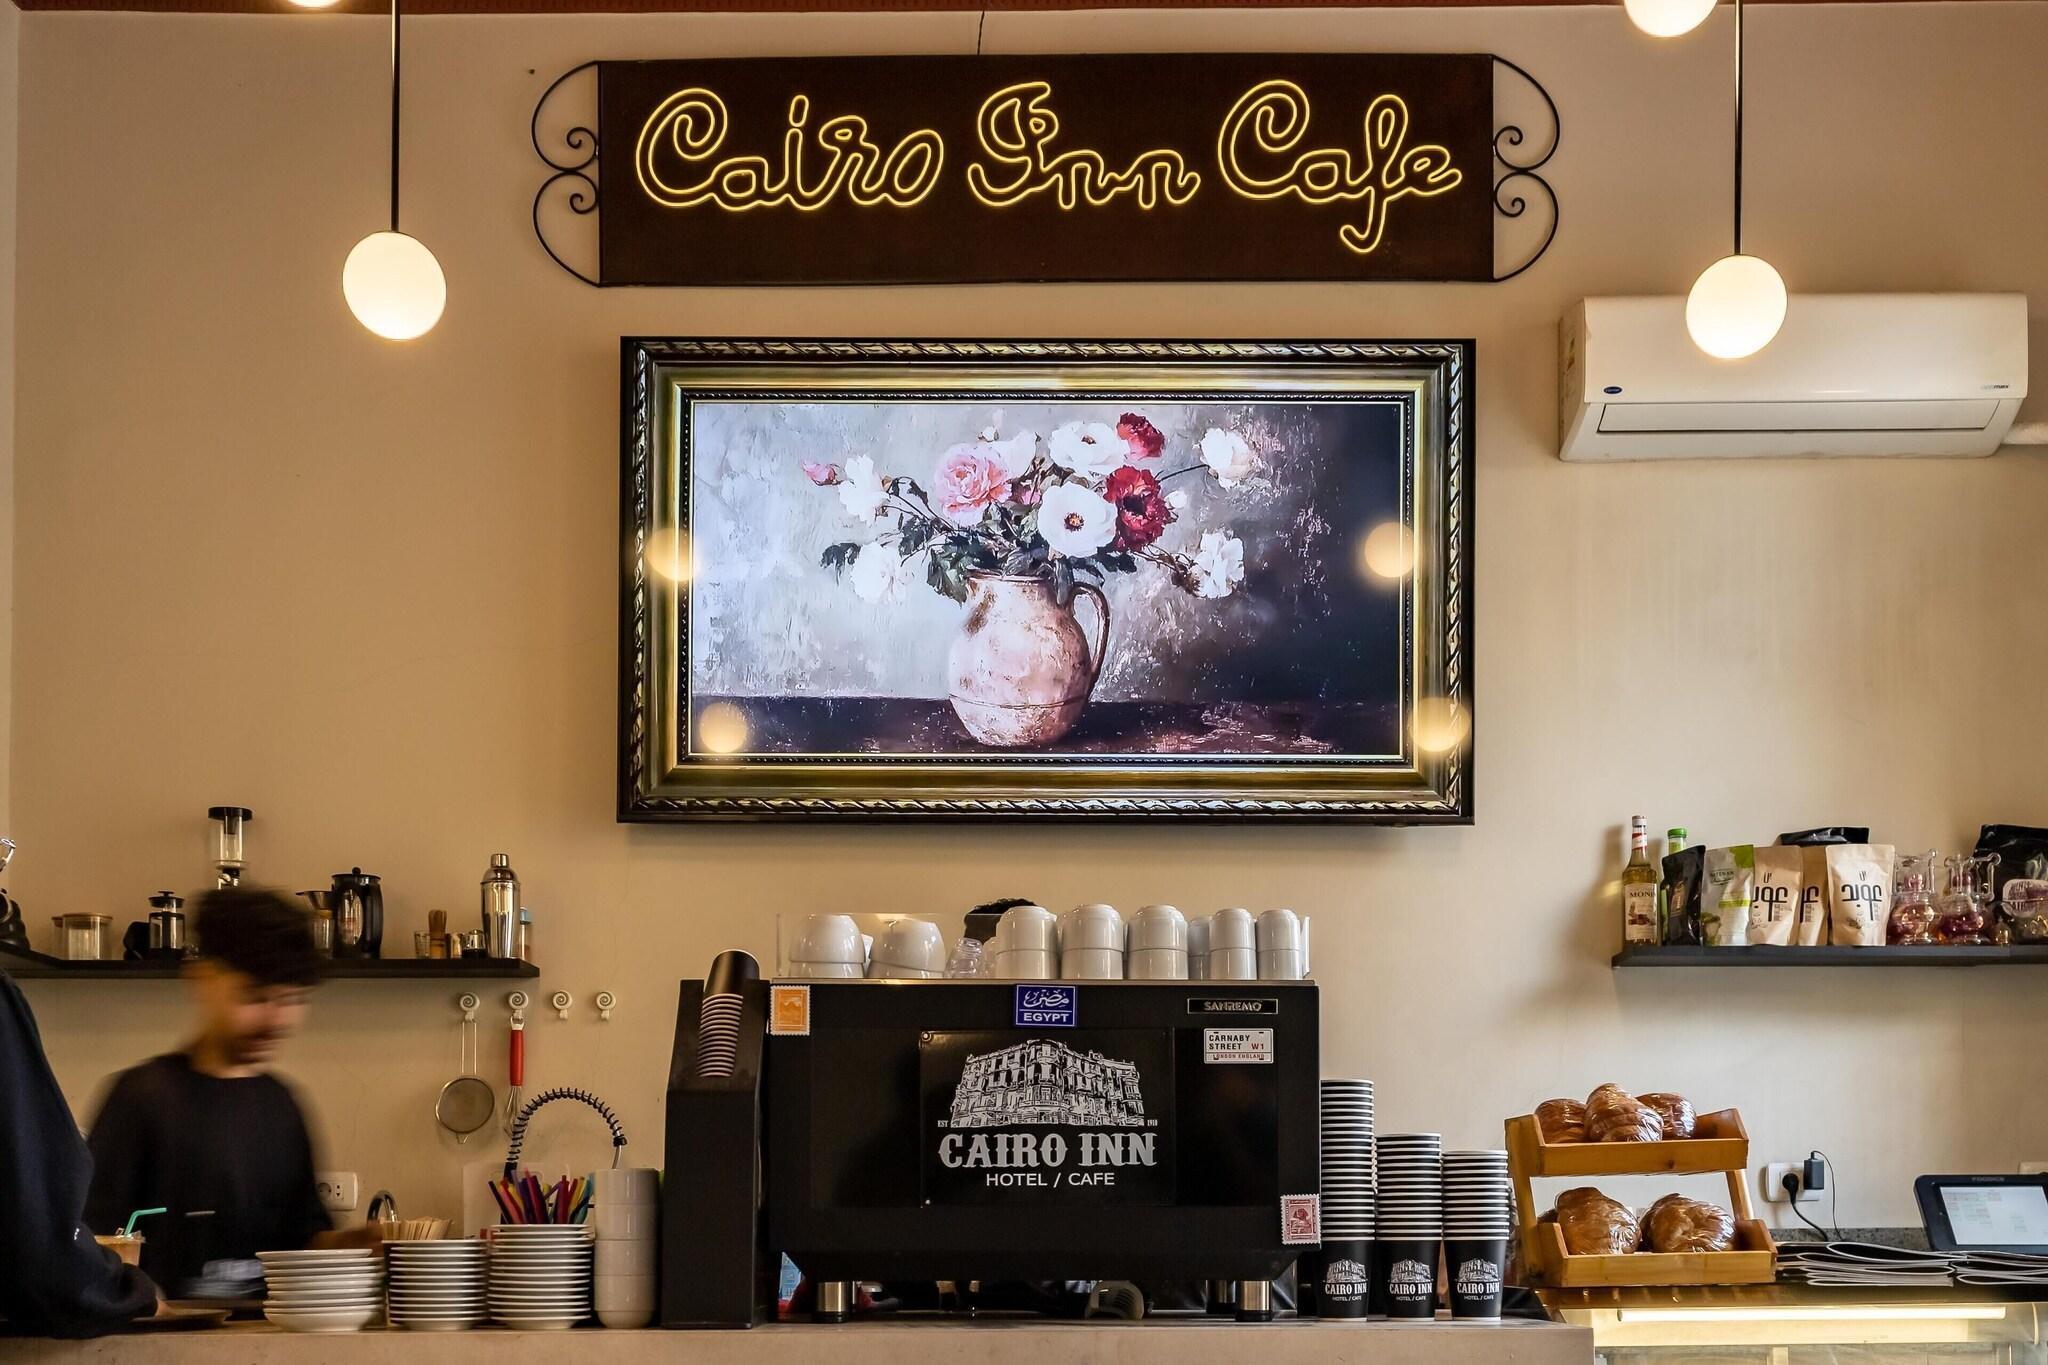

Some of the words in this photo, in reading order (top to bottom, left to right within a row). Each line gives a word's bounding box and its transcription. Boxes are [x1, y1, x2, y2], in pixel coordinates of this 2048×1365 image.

[636, 88, 944, 210] Cairo
[968, 81, 1201, 210] Inn
[1218, 80, 1463, 254] Cafe
[1204, 1001, 1262, 1012] SANREMO
[1023, 1012, 1070, 1023] EGYPT
[1209, 1034, 1250, 1042] CARNABY
[937, 1119, 949, 1128] EST
[938, 1133, 1068, 1168] CAIRO
[1077, 1132, 1158, 1167] INN
[986, 1173, 1048, 1187] HOTEL
[1068, 1172, 1115, 1186] CAFE
[1325, 1284, 1352, 1295] CAIRO
[1354, 1282, 1367, 1294] INN
[1389, 1284, 1416, 1295] CAIRO
[1418, 1283, 1433, 1294] INN
[1457, 1283, 1484, 1294] CAIRO
[1486, 1282, 1500, 1293] INN
